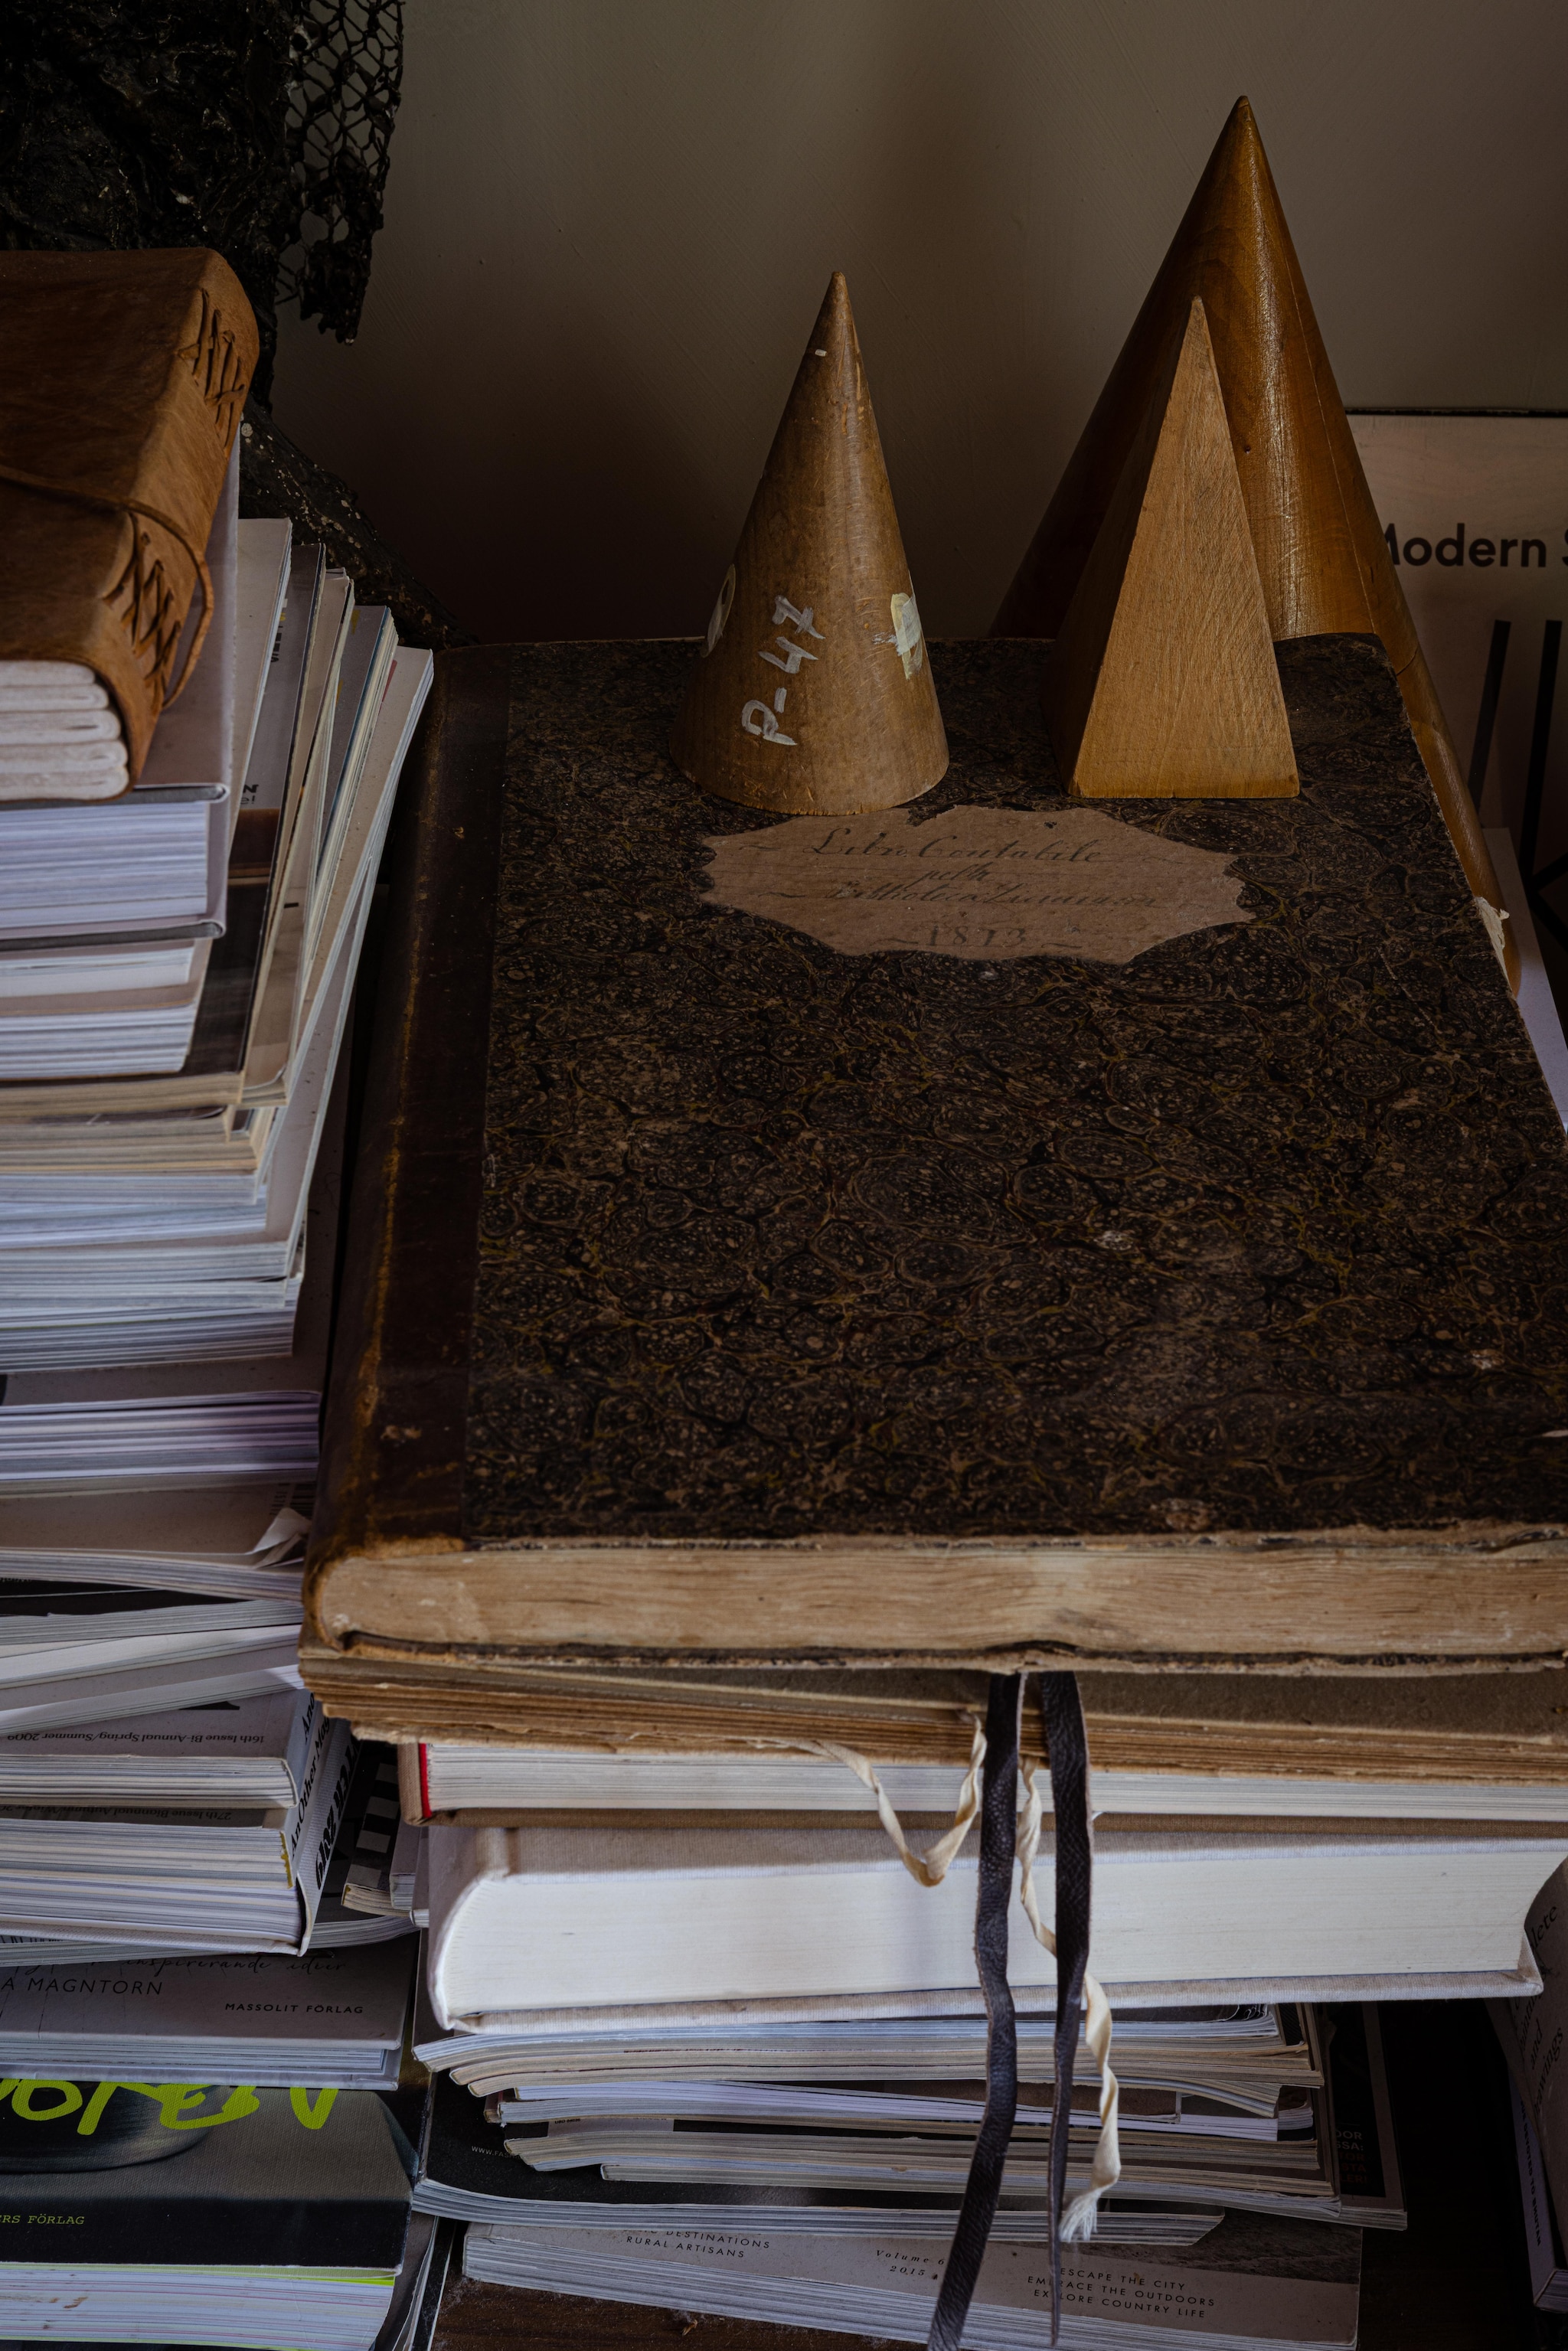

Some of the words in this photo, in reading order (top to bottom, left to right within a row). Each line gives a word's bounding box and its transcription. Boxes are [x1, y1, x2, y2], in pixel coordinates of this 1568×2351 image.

[41, 1732, 139, 1743] Spring/Summer
[142, 1732, 202, 1743] Bi-Annual
[205, 1734, 237, 1742] Issue
[240, 1735, 265, 1743] 16th
[315, 1716, 330, 1761] Mag
[113, 1807, 168, 1818] Biannual
[172, 1810, 204, 1820] Issue
[206, 1811, 232, 1820] 27th
[1530, 1906, 1557, 1949] lete
[28, 1977, 163, 1995] MAGNTORN
[225, 2003, 299, 2013] MASSOLIT
[306, 2003, 364, 2014] FÖRLAG
[1534, 2027, 1563, 2116] rawings
[0, 2214, 21, 2224] RS
[28, 2213, 85, 2225] FÖRLAG
[626, 2235, 668, 2248] RURAL
[676, 2242, 745, 2258] ARTISANS
[876, 2250, 929, 2263] Volume
[890, 2265, 926, 2276] 2015
[1060, 2268, 1112, 2281] ESCAPE
[1121, 2275, 1145, 2286] THE
[1154, 2280, 1186, 2291] CITY
[1102, 2285, 1126, 2296] THE
[1135, 2291, 1215, 2307] OUTDOORS
[1034, 2289, 1093, 2304] EXLORE
[1102, 2298, 1170, 2313] COUNTRY
[1178, 2308, 1206, 2318] LIFE
